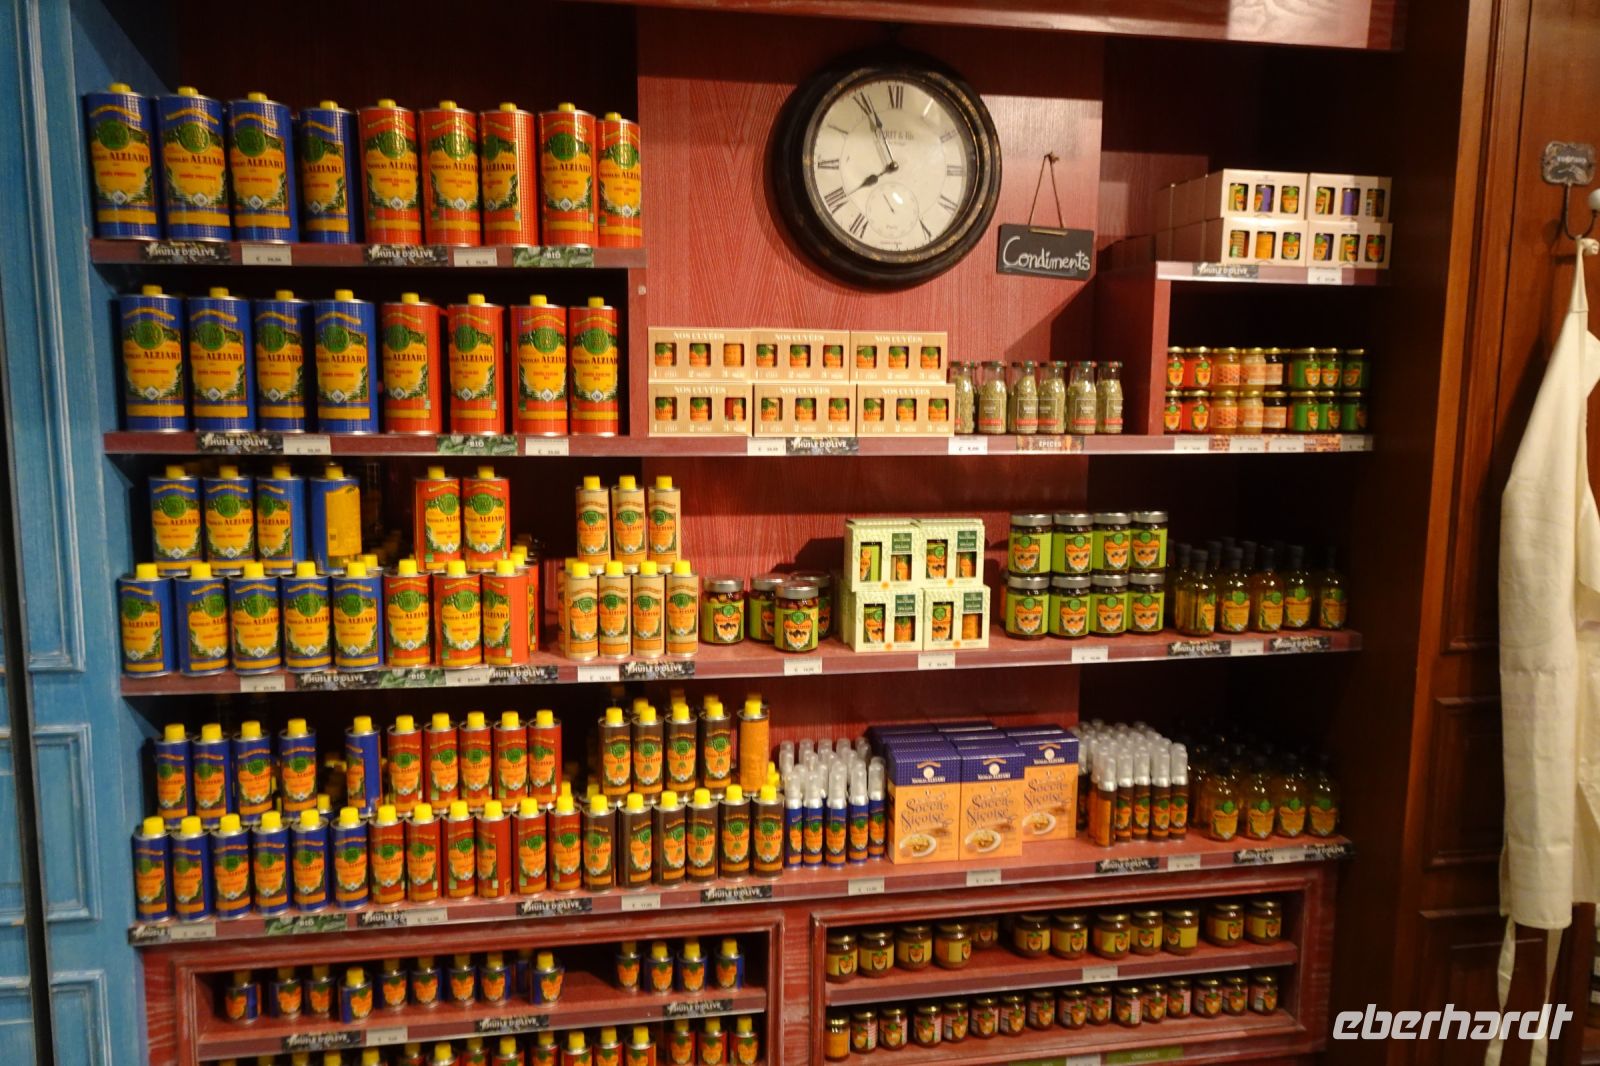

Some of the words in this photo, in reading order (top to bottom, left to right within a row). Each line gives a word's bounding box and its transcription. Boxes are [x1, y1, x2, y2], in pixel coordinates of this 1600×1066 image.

[155, 248, 181, 256] HUILE
[182, 248, 216, 257] D'OLIVE
[377, 250, 400, 258] HUILE
[402, 250, 433, 258] D'OLIVE
[546, 251, 561, 259] BIO
[1002, 234, 1091, 271] Condiments
[143, 350, 180, 361] ALZIARI
[206, 351, 243, 362] ALZIARI
[331, 353, 366, 363] ALZIARI
[392, 354, 426, 363] ALZIARI
[210, 438, 235, 446] HUILE
[236, 438, 268, 447] D'OLIVE
[798, 440, 818, 448] HUILE
[819, 440, 846, 448] D'OLIVE
[493, 669, 513, 678] HUILE
[632, 665, 654, 673] HUILE
[309, 675, 332, 683] HUILE
[711, 889, 732, 898] HUILE
[529, 903, 550, 911] HUILE
[369, 913, 392, 922] HUILE
